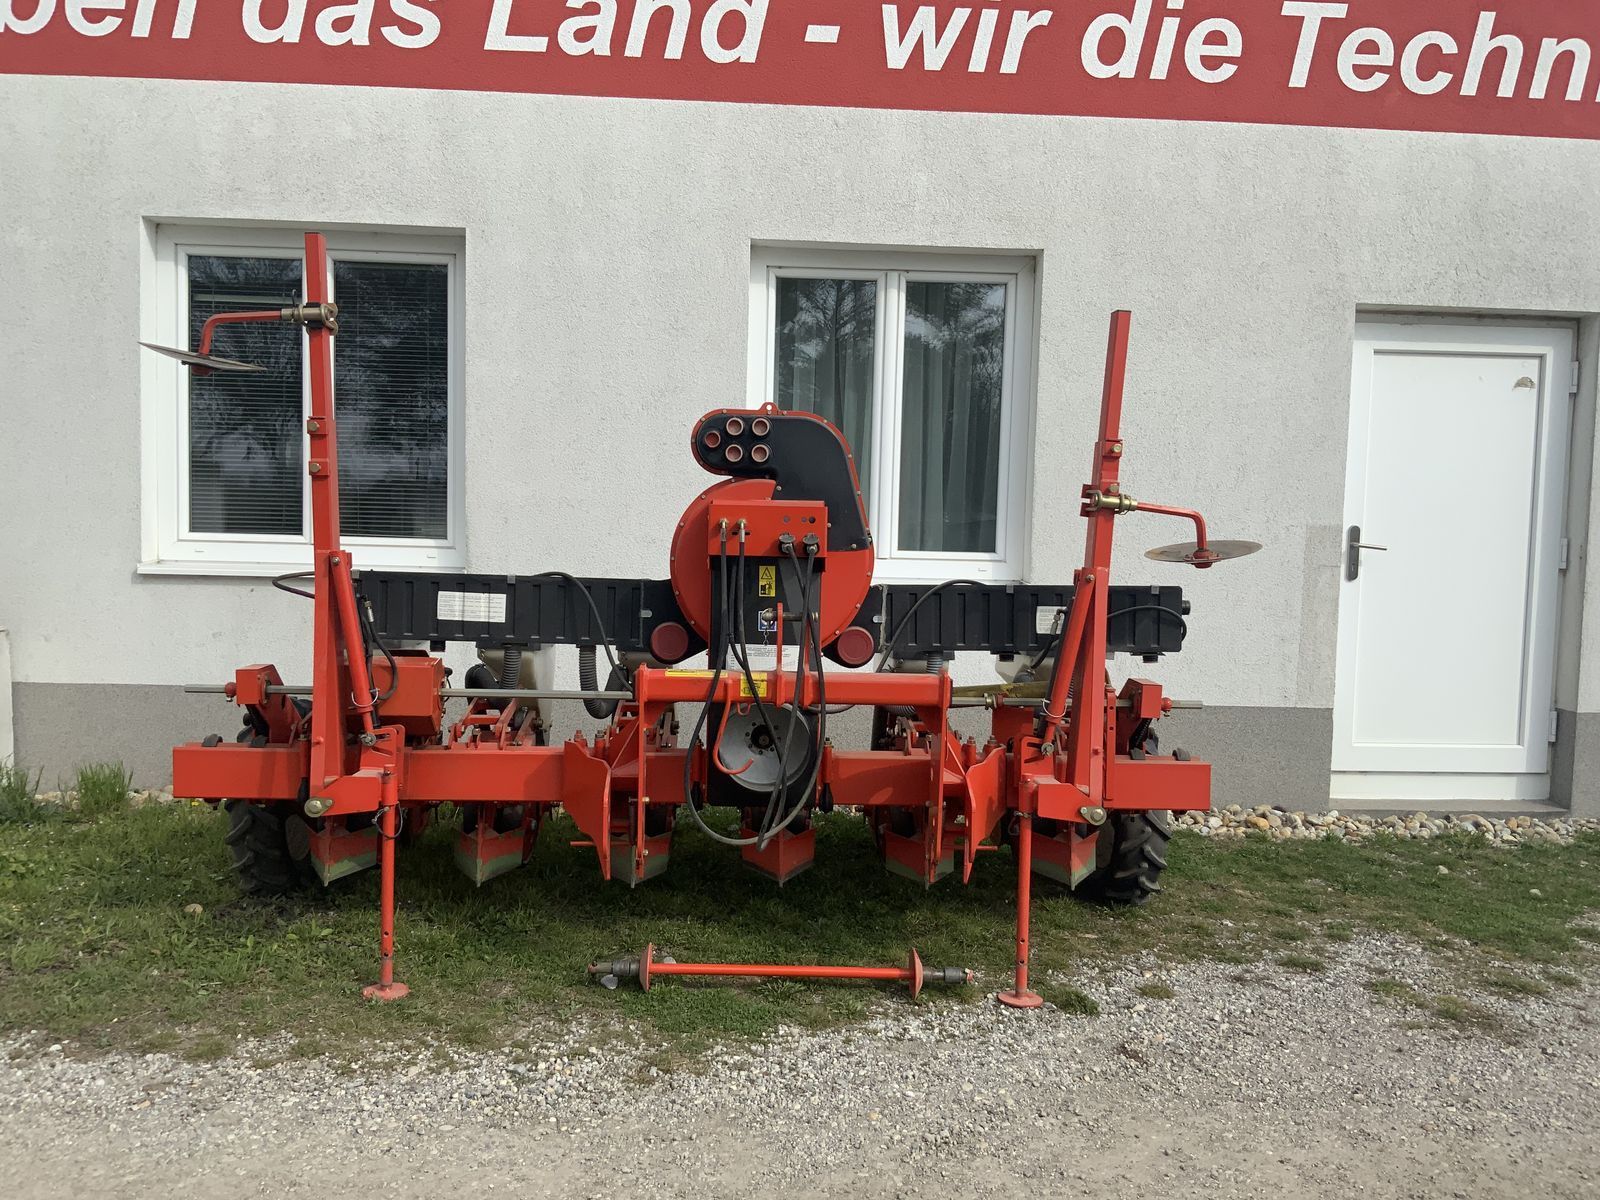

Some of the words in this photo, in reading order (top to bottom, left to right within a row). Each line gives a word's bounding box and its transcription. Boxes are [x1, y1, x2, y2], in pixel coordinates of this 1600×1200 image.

[241, 0, 441, 49] das
[483, 0, 770, 64] Land
[881, 0, 1054, 74] wir
[1080, 0, 1243, 84] die
[1280, 0, 1600, 103] Techn
